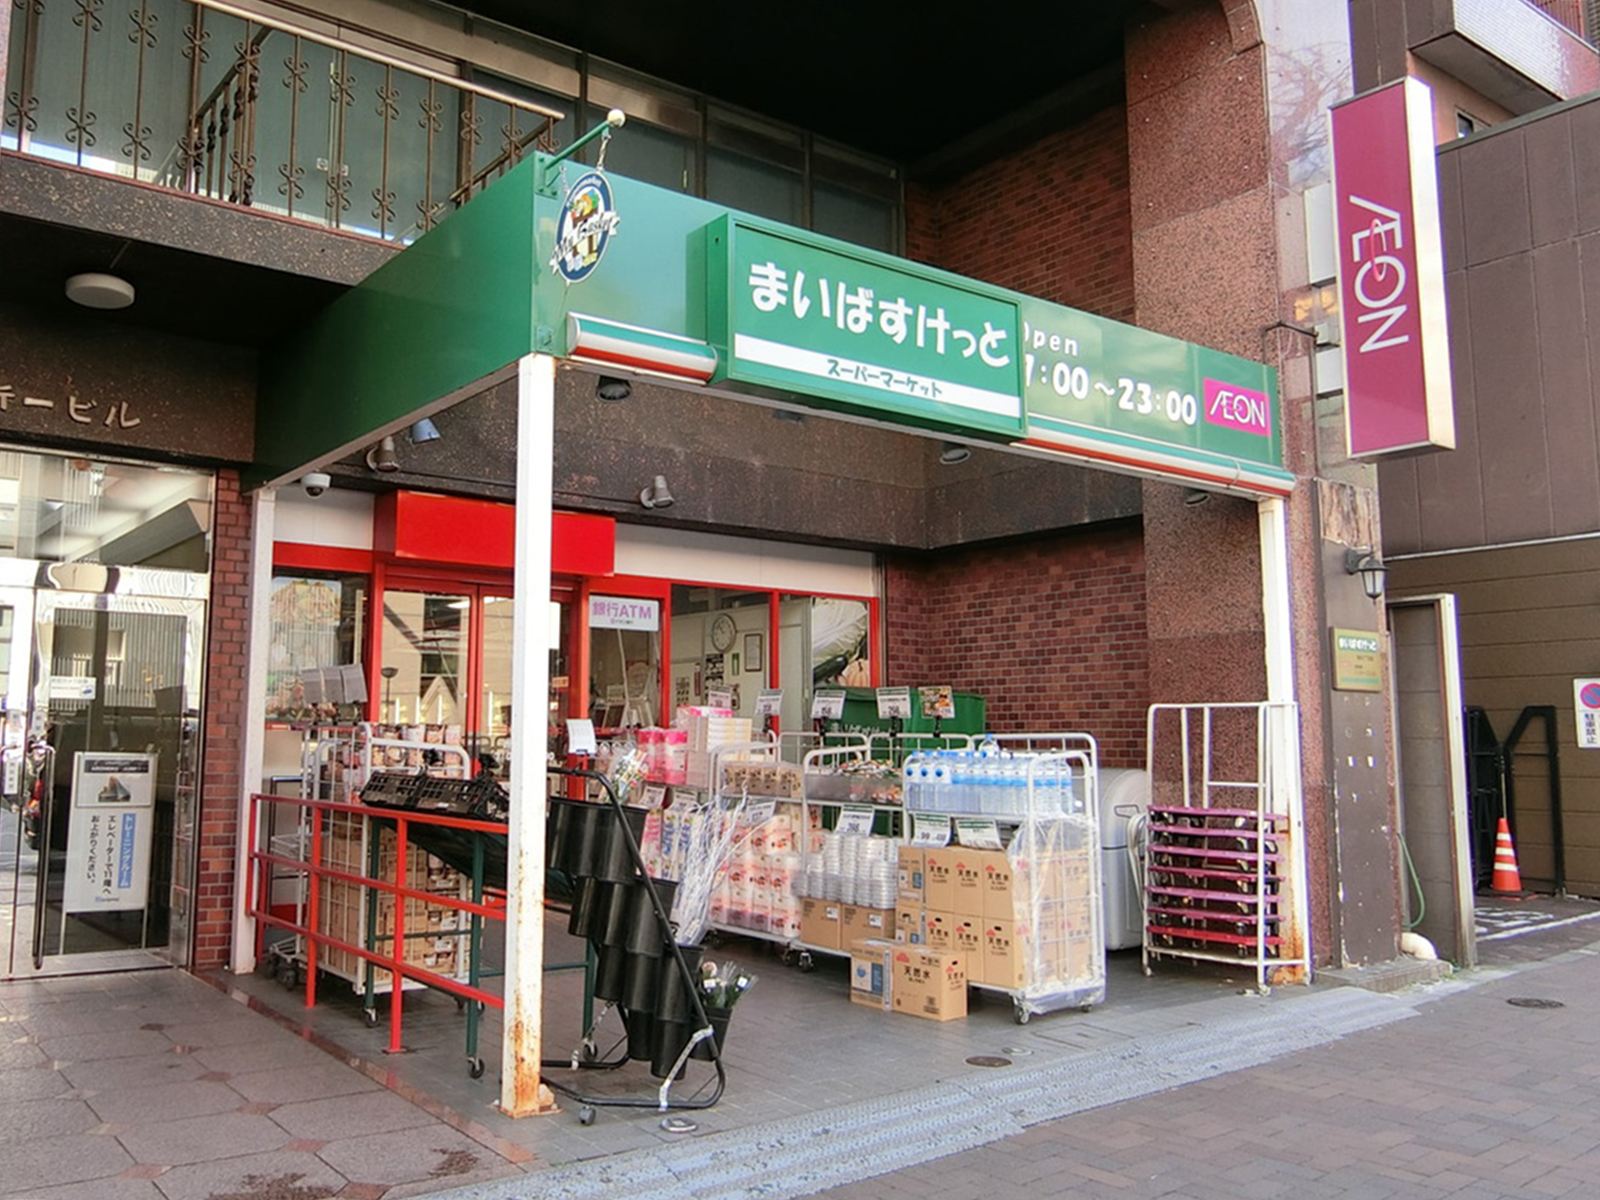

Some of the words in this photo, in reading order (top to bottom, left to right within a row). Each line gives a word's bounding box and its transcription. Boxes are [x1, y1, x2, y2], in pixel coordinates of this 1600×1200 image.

[748, 261, 1011, 368] まいばすけっと
[826, 358, 943, 398] スーパーマーケット
[592, 601, 652, 620] 銀行ATM
[119, 815, 134, 888] トレーニングルーム
[903, 965, 931, 979] 天然水
